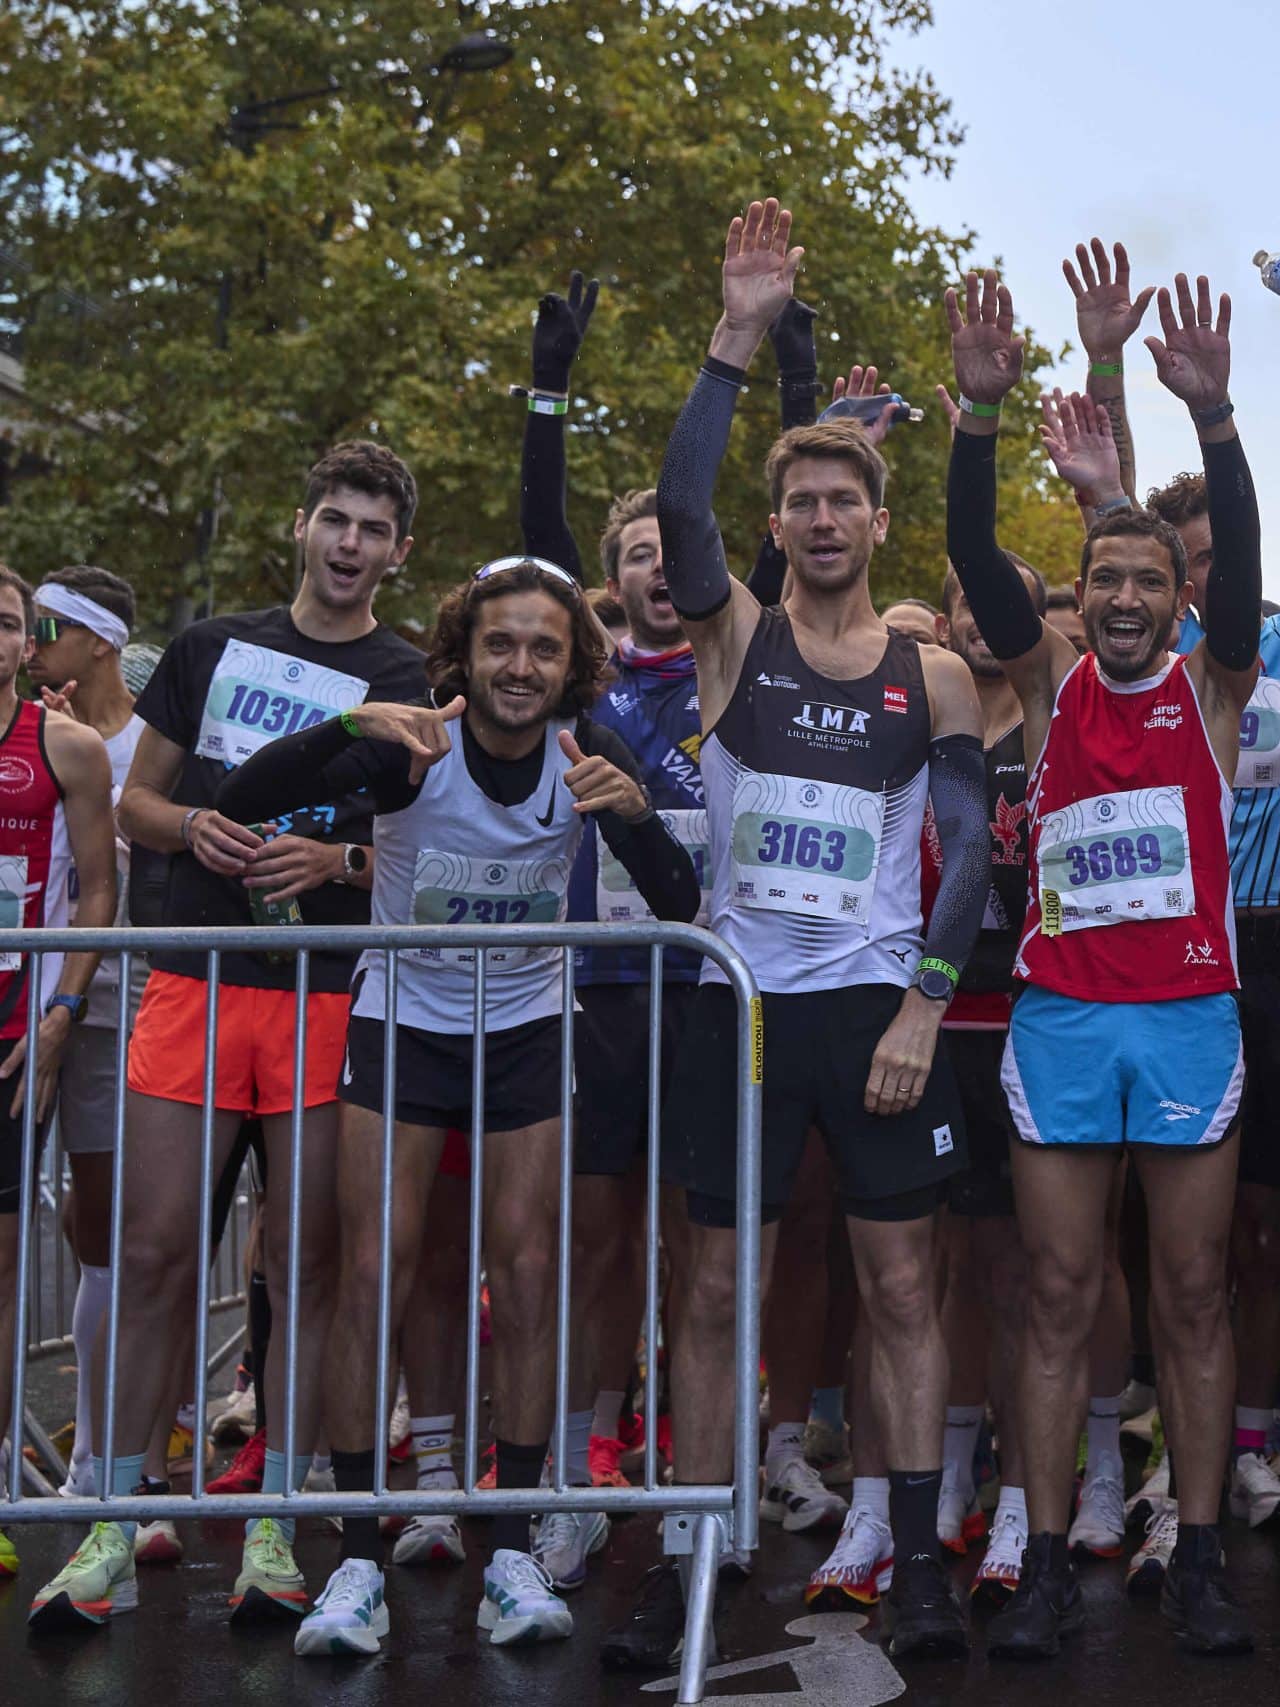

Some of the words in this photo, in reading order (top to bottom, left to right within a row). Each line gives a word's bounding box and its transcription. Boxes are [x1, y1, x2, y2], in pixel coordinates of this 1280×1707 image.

[884, 691, 908, 703] MEL
[801, 704, 867, 734] LMA
[1144, 715, 1183, 730] Eiffage
[787, 729, 812, 740] LILLE
[758, 820, 847, 873] 3163
[1065, 833, 1162, 885] 3689
[447, 897, 530, 924] 2312
[1046, 893, 1059, 930] 11800
[920, 959, 953, 977] ELITE
